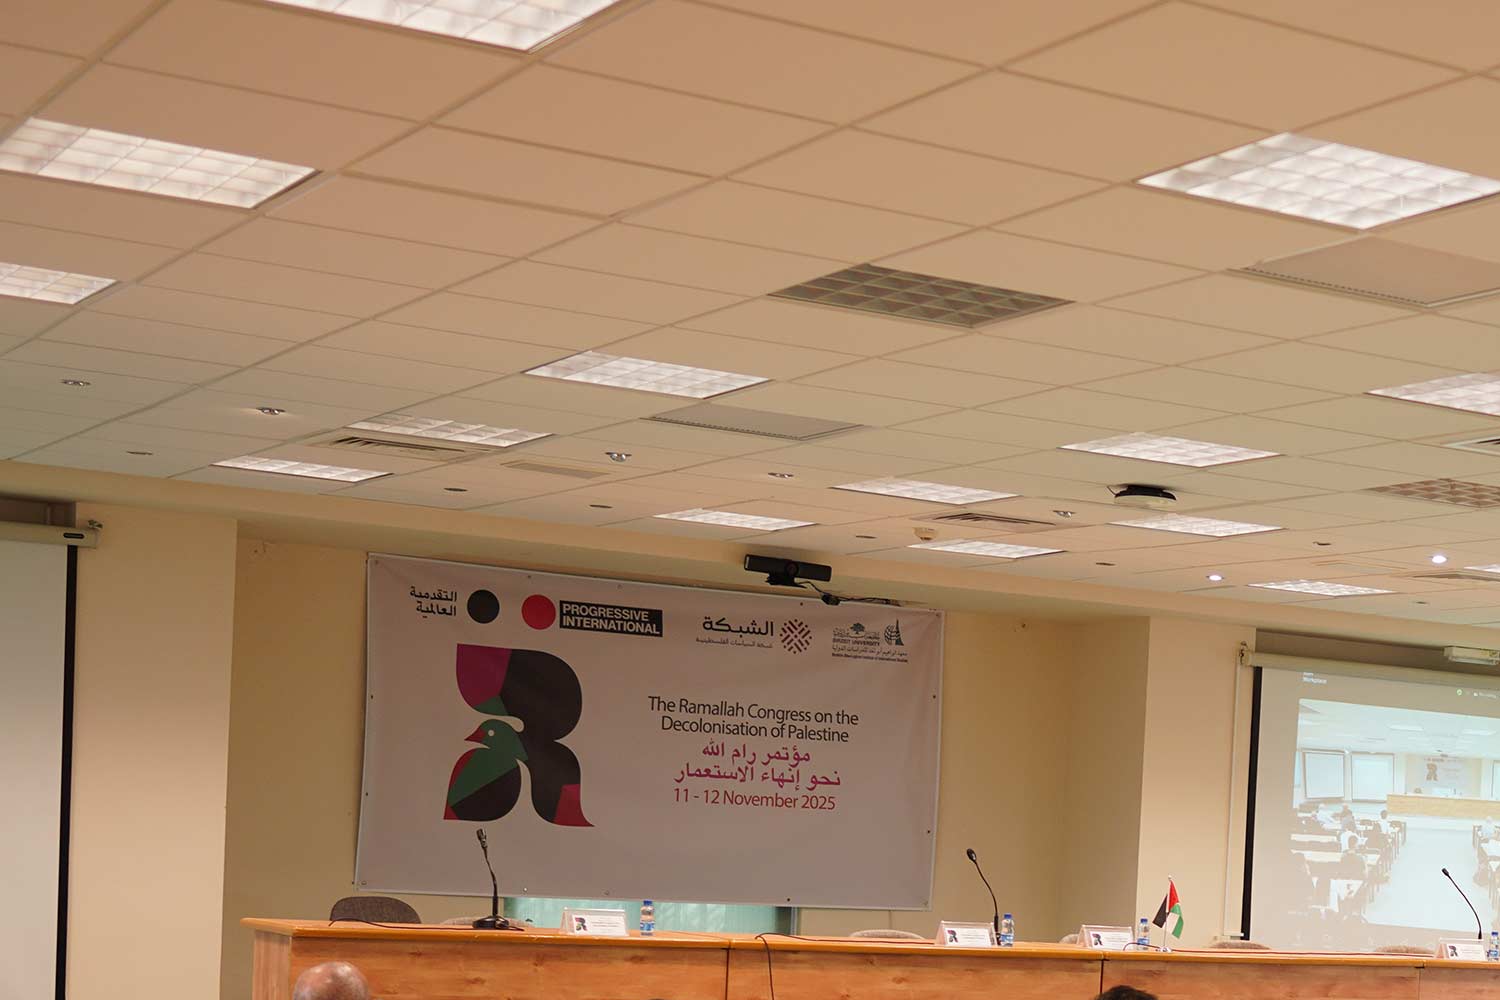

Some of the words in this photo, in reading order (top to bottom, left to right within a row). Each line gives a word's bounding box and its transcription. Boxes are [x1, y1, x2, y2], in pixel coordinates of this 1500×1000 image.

[410, 586, 457, 602] التقدمية
[416, 601, 457, 618] العالمية
[562, 603, 649, 622] PROGRESSIVE
[562, 616, 660, 635] INTERNATIONAL
[702, 616, 774, 638] الشبكة
[648, 696, 676, 713] The
[679, 699, 745, 718] Ramallah
[748, 704, 811, 724] Congress
[814, 711, 833, 723] on
[836, 710, 859, 725] the
[661, 716, 768, 737] Decolonisation
[771, 723, 786, 738] of
[788, 725, 849, 742] Palestine
[702, 738, 725, 757] الله
[732, 743, 756, 765] رام
[761, 745, 811, 768] مؤتمر
[674, 763, 754, 783] الاستعمار
[761, 767, 800, 791] إنهاء
[806, 770, 841, 791] نحو
[674, 788, 689, 802] 11
[704, 789, 720, 804] 12
[723, 790, 799, 809] November
[801, 794, 836, 810] 2025
